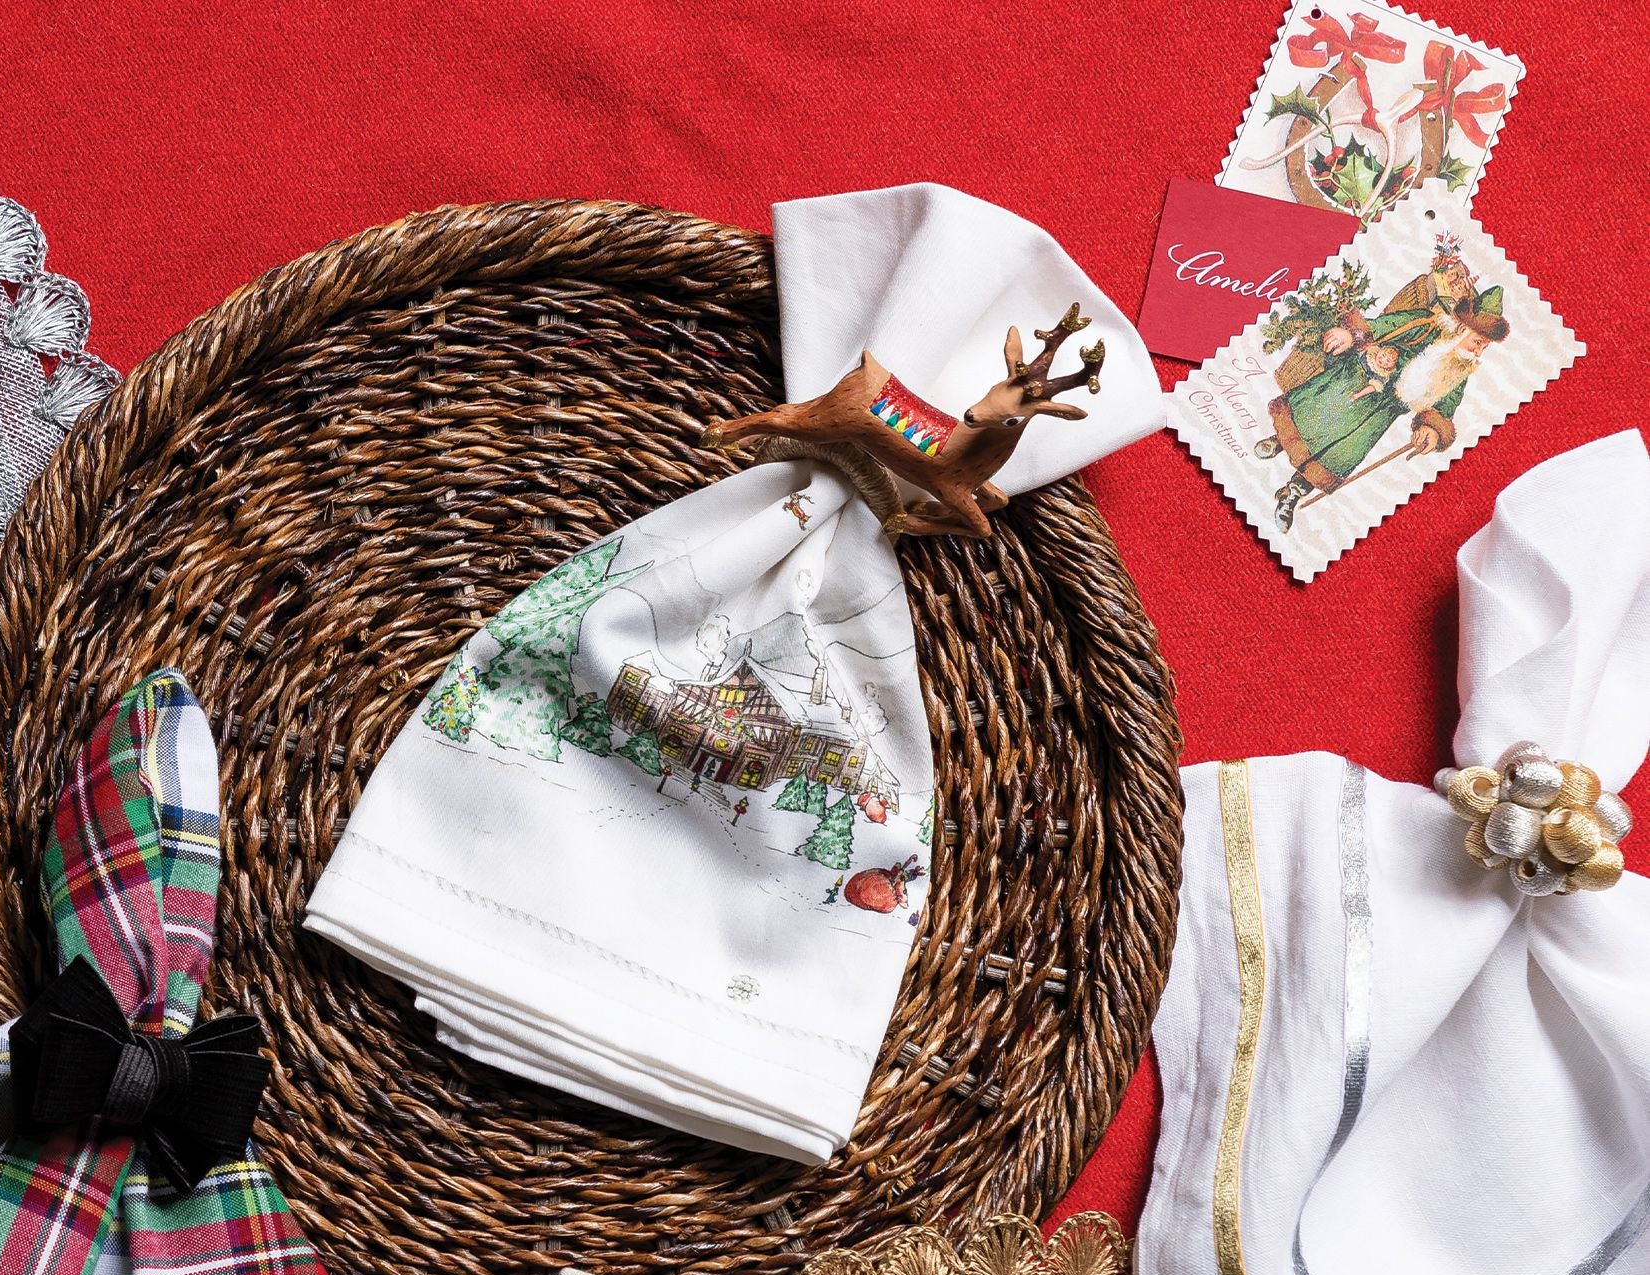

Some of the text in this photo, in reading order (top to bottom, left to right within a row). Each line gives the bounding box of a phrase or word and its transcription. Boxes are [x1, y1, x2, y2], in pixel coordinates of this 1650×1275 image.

[1167, 243, 1289, 302] Ameli
[1188, 390, 1249, 459] Christmas
[1207, 372, 1259, 430] Merry
